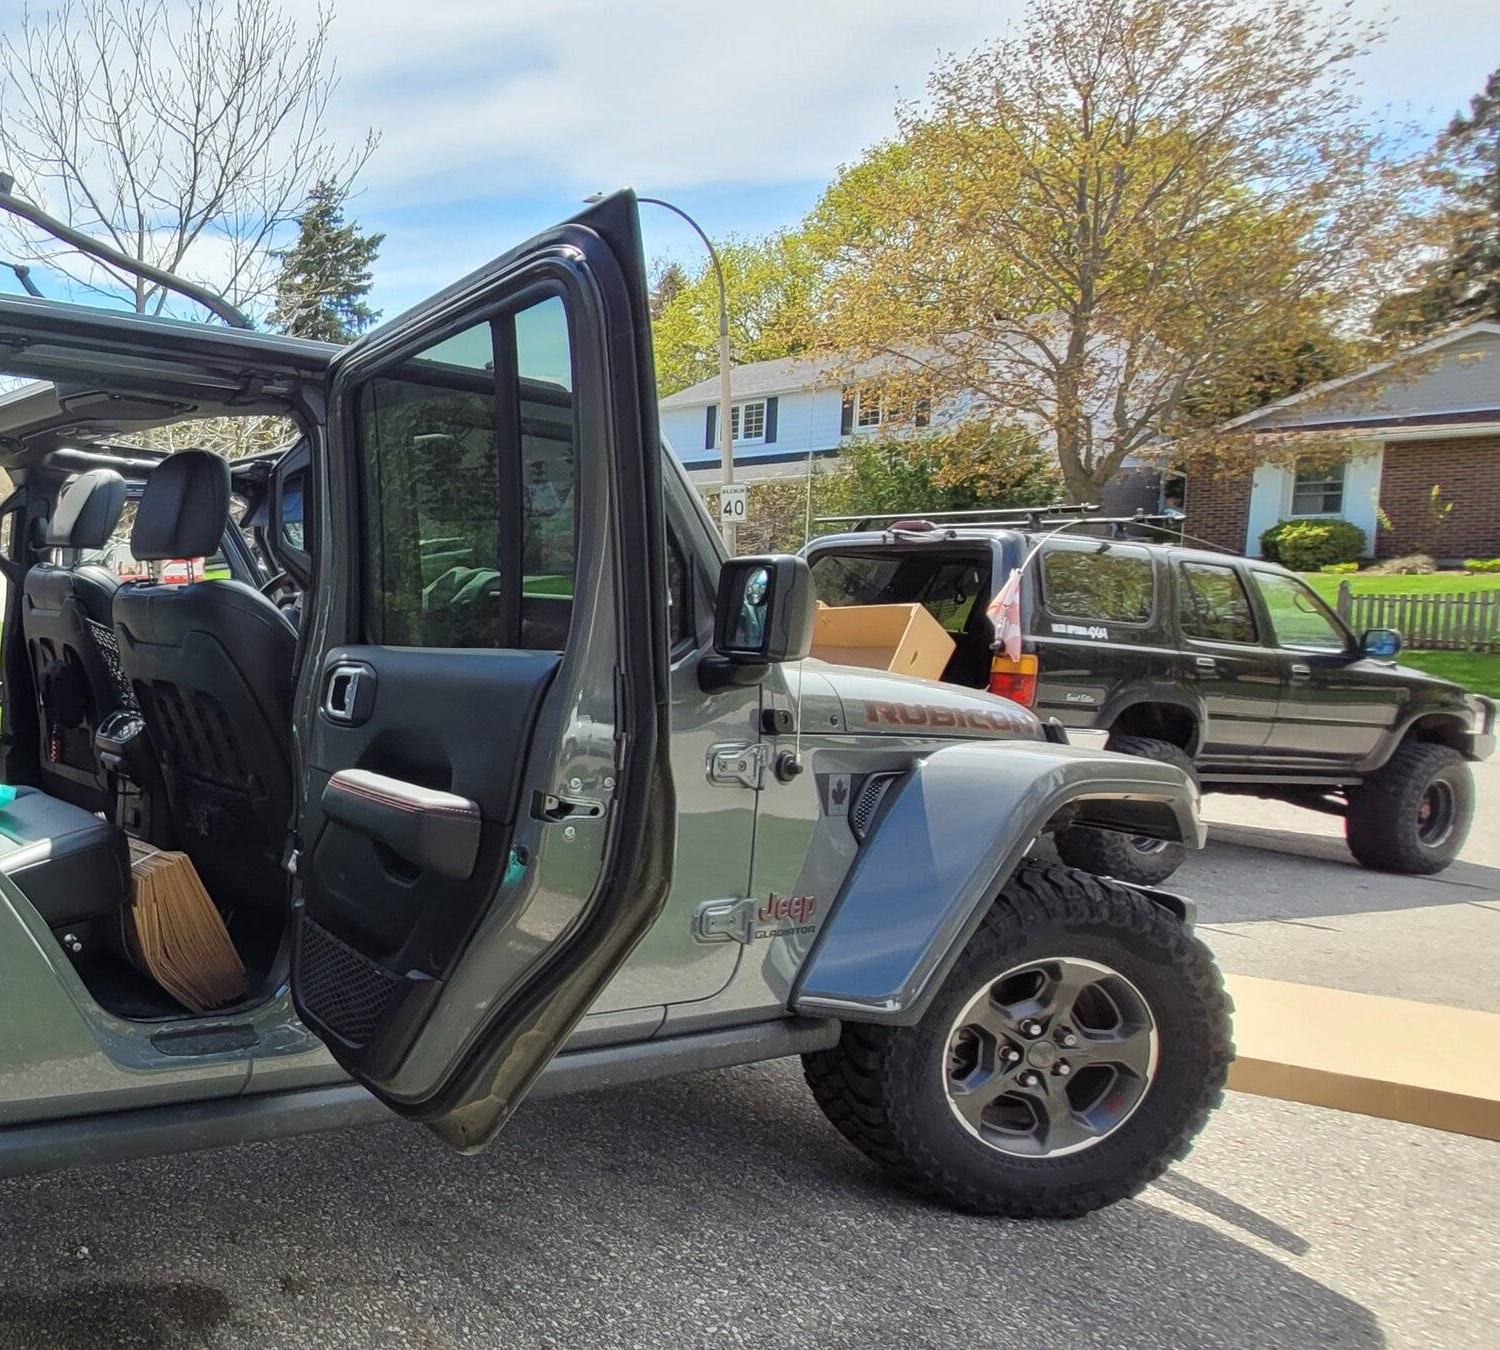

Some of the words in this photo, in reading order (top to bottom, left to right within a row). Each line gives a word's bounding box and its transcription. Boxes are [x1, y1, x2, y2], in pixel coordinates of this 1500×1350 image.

[723, 500, 744, 516] 40
[864, 701, 1037, 736] RUBICON
[759, 892, 815, 923] Jeep
[755, 925, 816, 939] GLADIATOR
